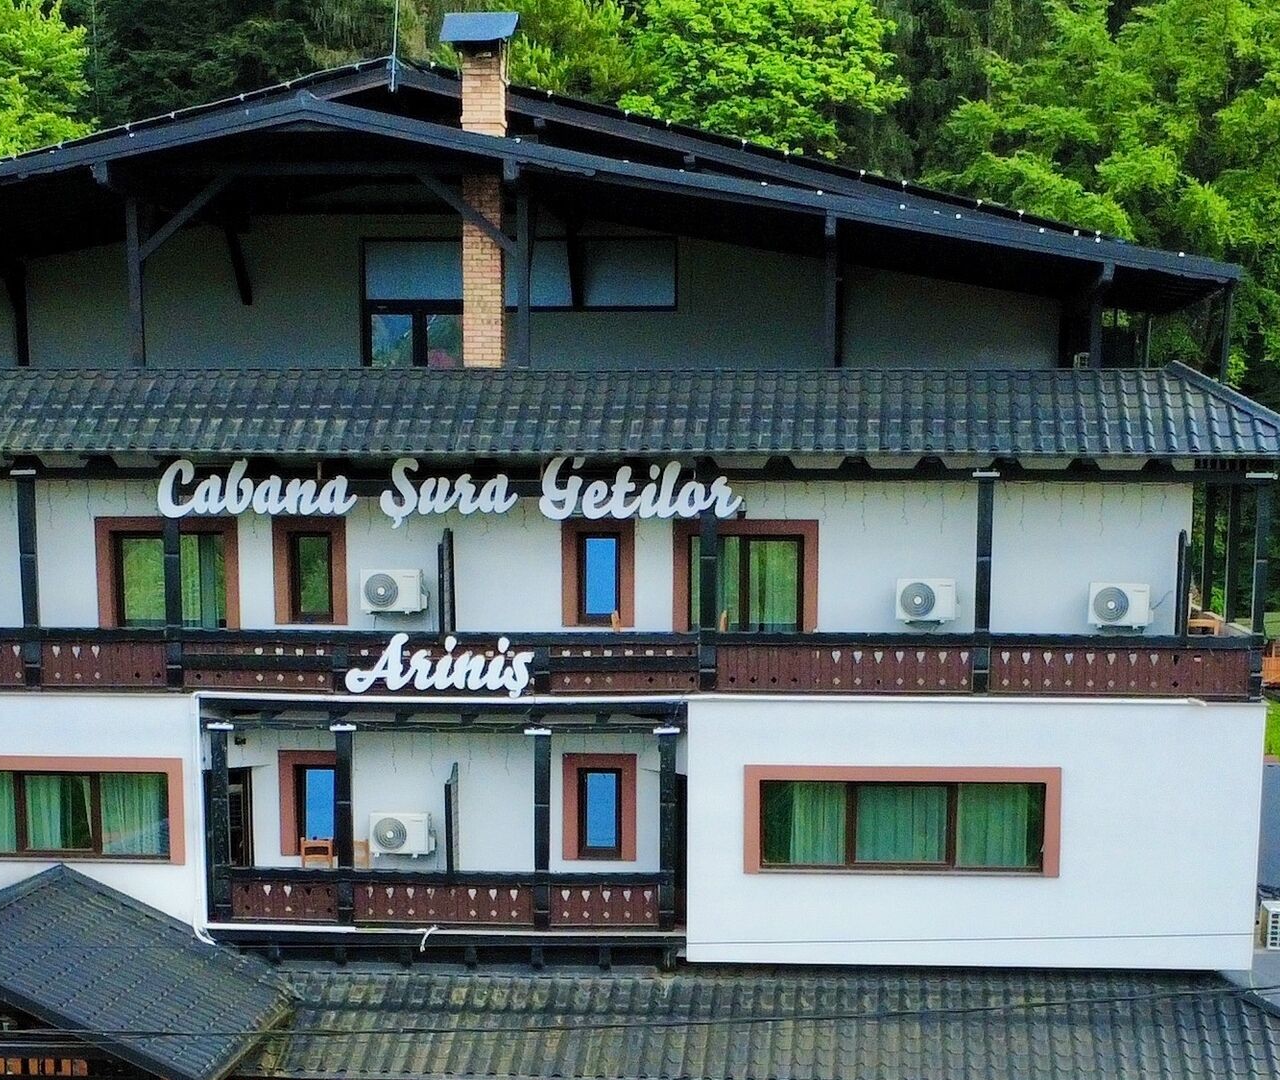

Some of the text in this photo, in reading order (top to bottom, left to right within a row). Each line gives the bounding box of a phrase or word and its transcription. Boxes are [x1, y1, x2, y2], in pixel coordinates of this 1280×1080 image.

[157, 455, 743, 530] Cabana Șura Getilor
